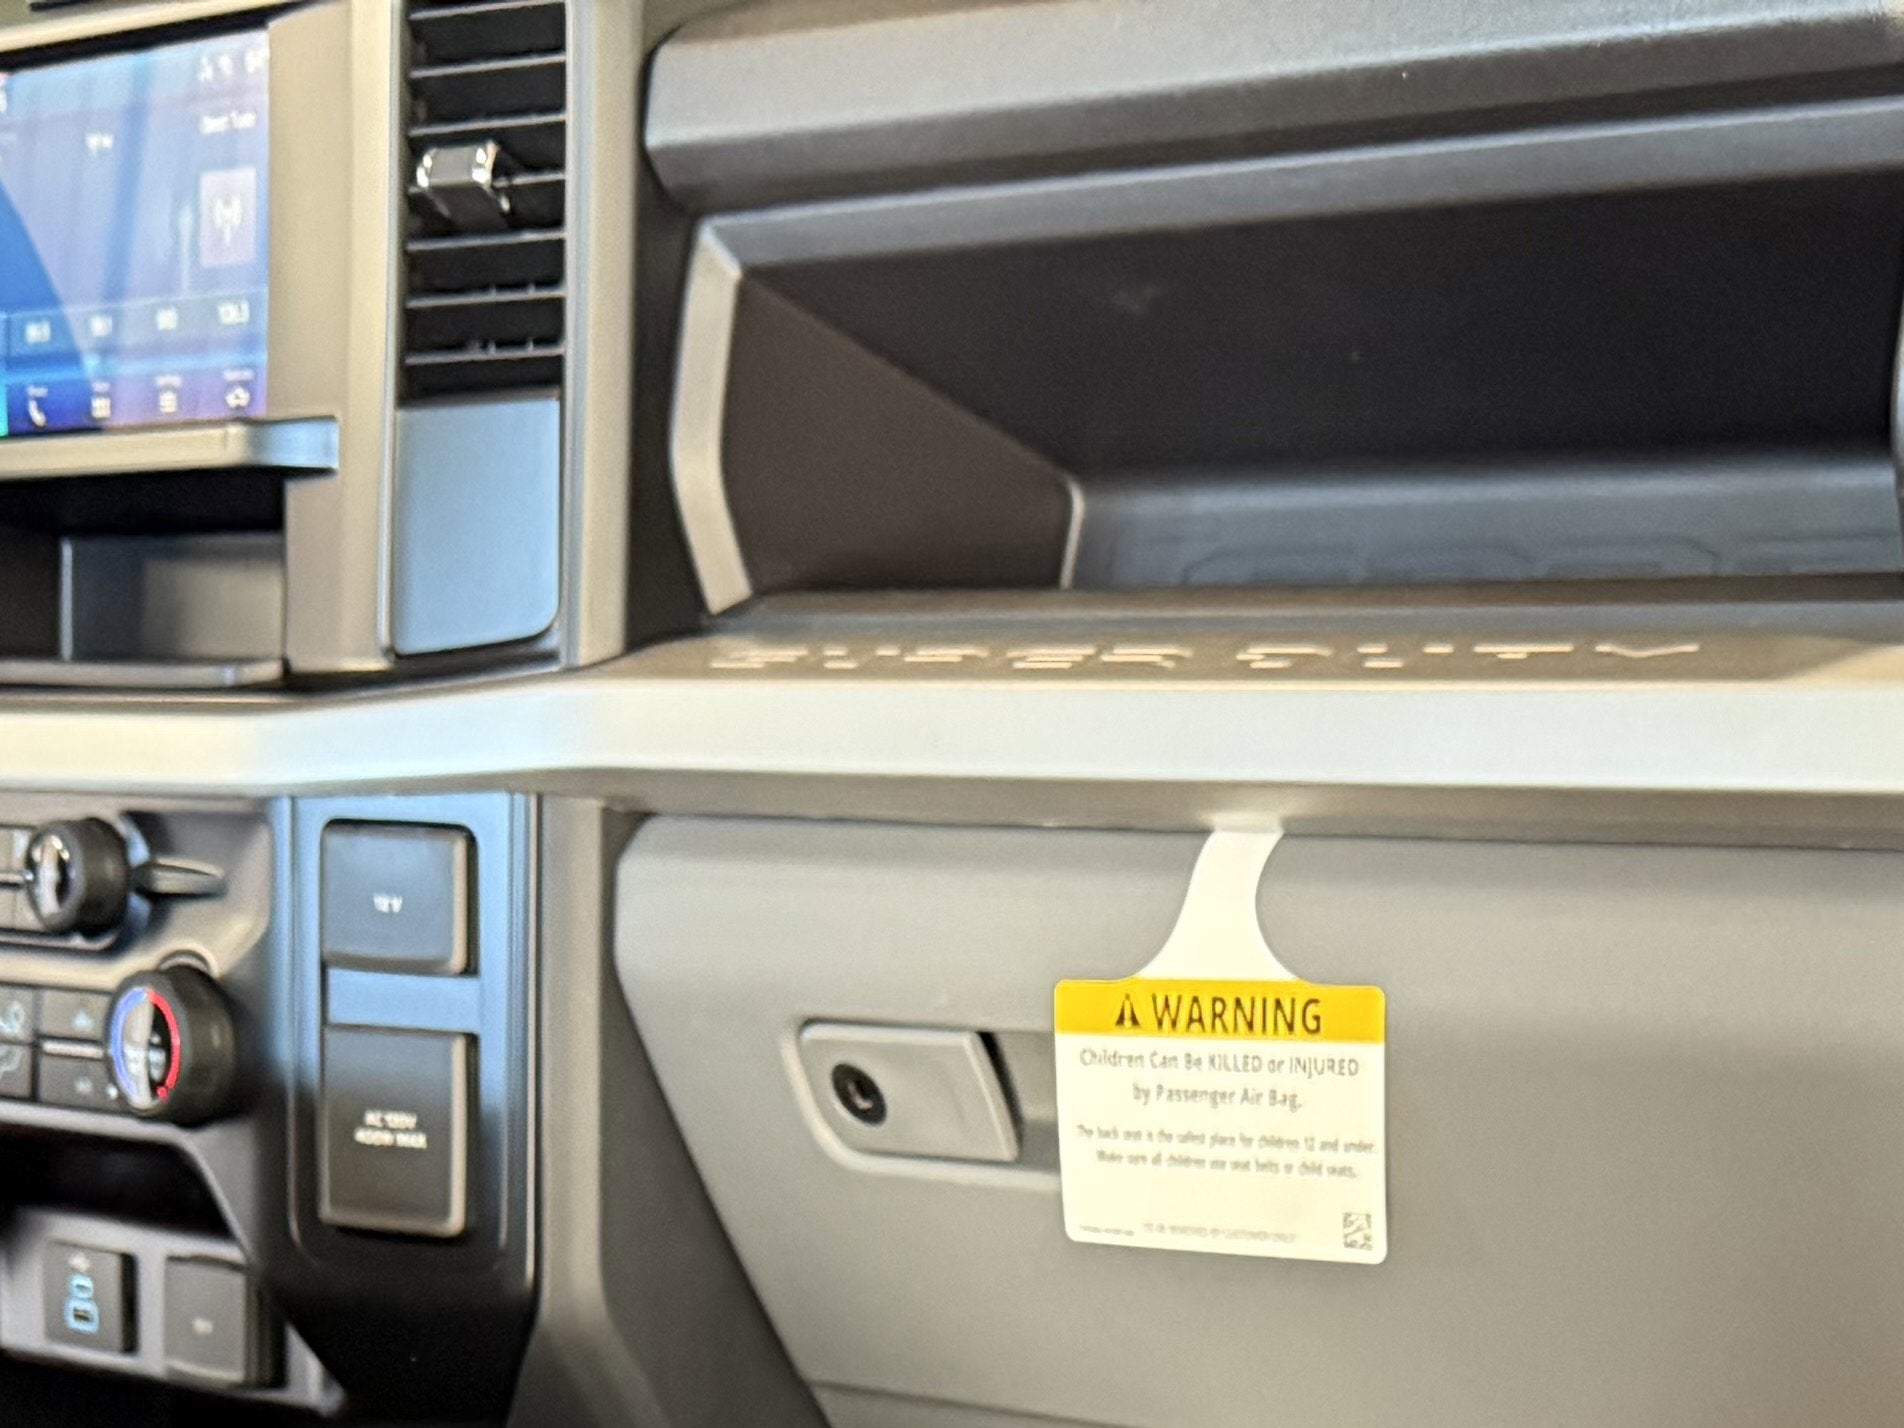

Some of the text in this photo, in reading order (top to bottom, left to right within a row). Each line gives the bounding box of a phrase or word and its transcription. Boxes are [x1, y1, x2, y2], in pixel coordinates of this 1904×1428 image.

[1151, 993, 1322, 1035] WARNING
[1079, 1047, 1360, 1079] Children Can Be KILLED or INJURED
[1132, 1083, 1303, 1111] by Passenger Air Bag.
